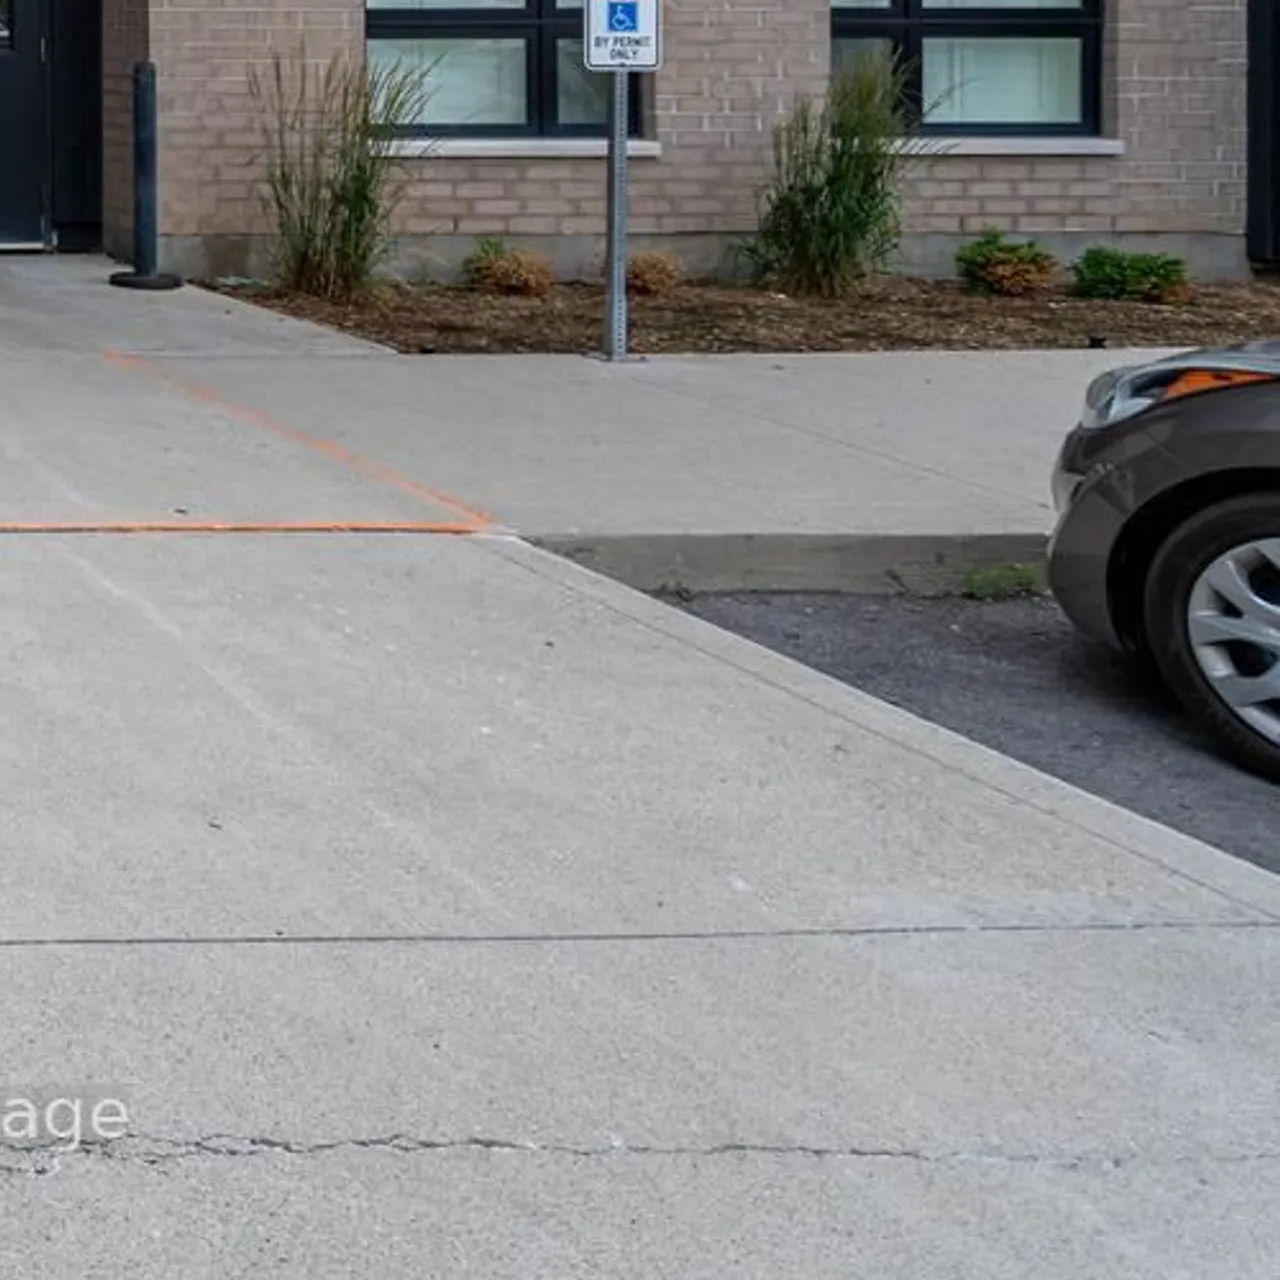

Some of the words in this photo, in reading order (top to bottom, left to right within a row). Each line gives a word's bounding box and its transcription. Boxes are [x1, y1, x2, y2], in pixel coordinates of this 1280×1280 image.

[594, 36, 610, 48] BY
[612, 36, 652, 48] PERMIT
[609, 48, 639, 60] ONLY
